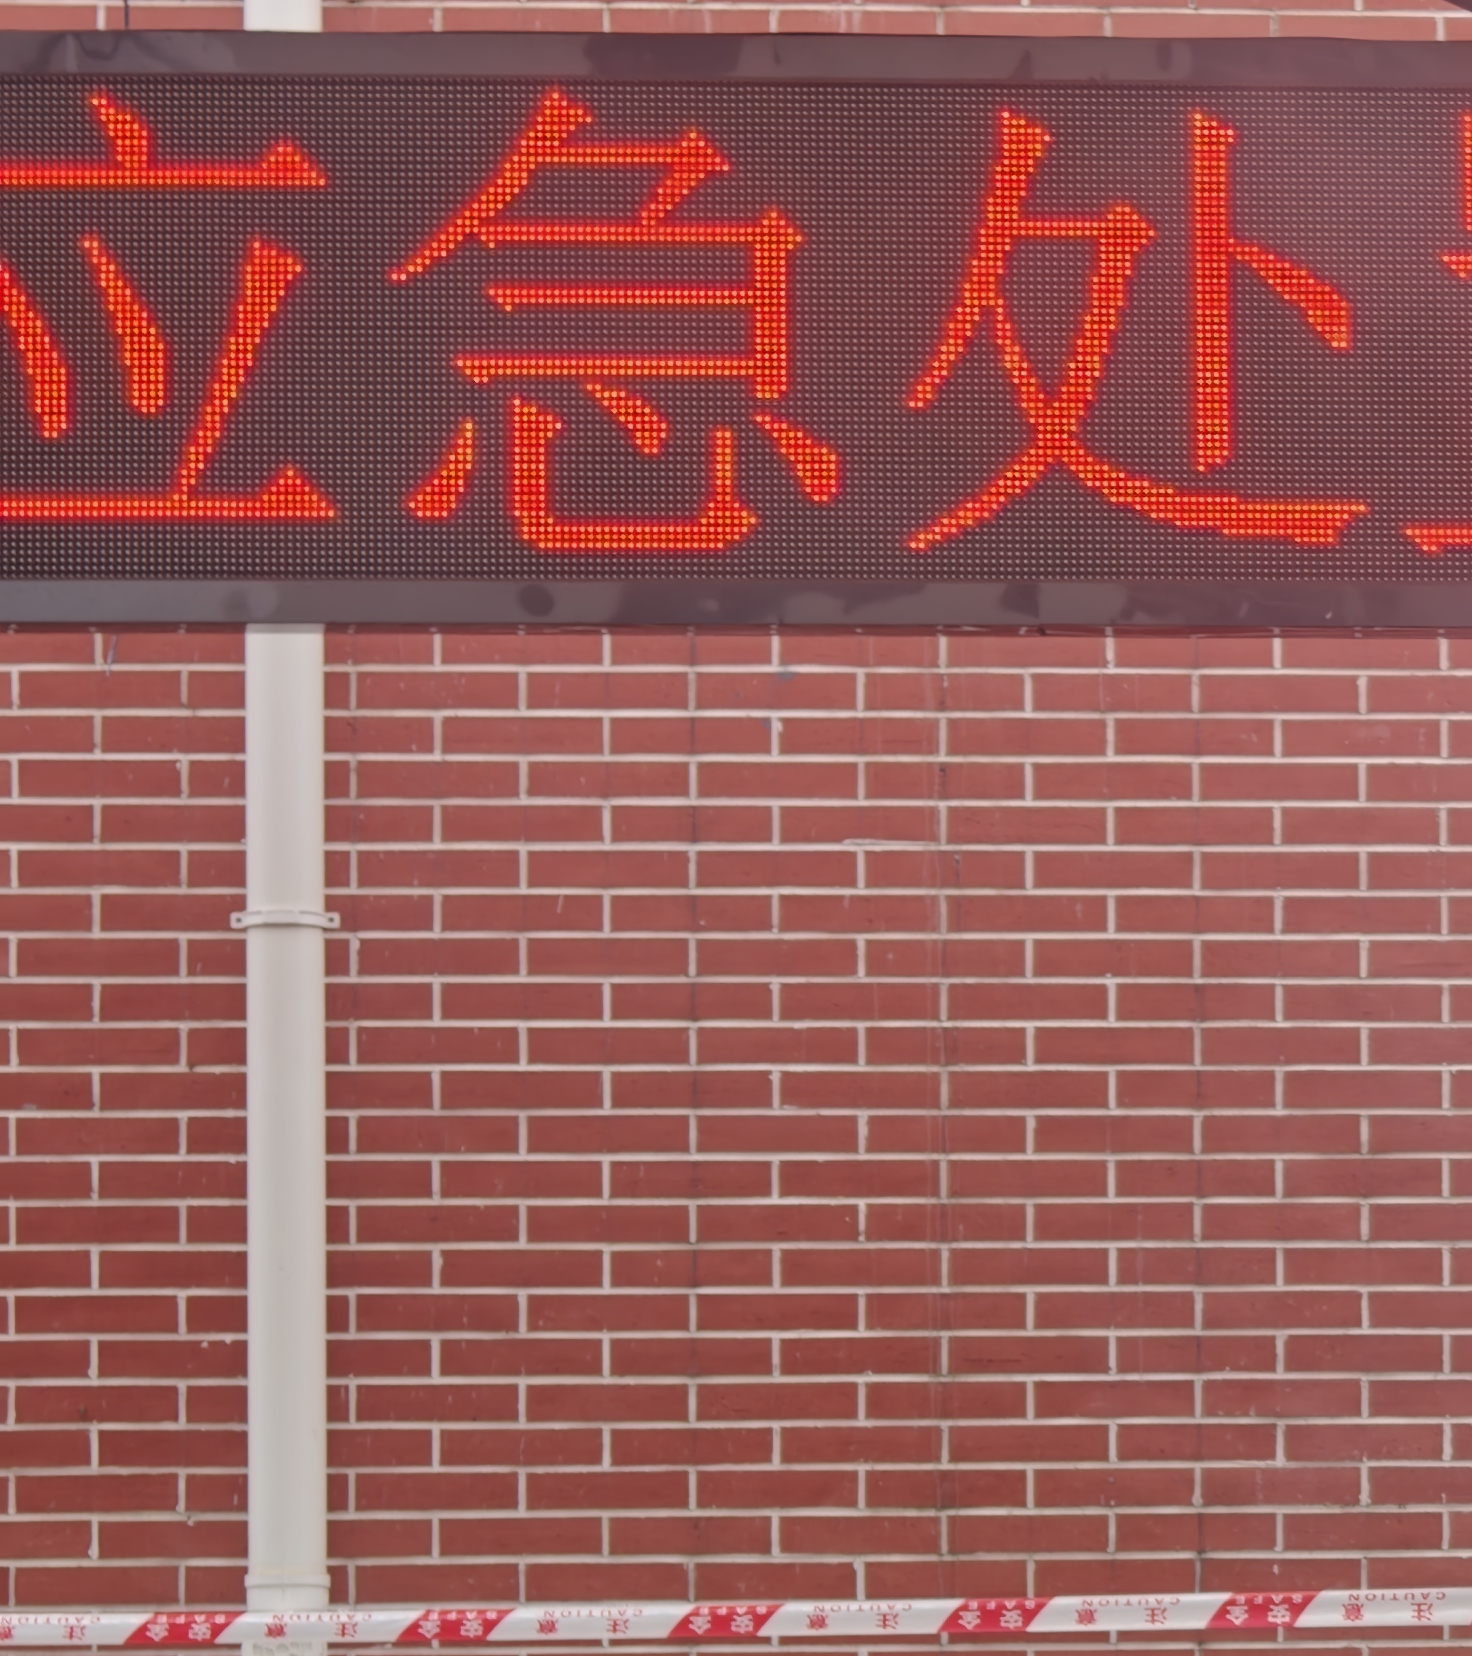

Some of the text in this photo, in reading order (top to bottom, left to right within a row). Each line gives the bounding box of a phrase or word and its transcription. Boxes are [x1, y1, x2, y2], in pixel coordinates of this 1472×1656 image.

[1081, 1597, 1180, 1607] CAUTION
[1236, 1594, 1303, 1604] SAFE
[1349, 1591, 1446, 1601] CAUTION
[698, 1605, 767, 1616] SAFE
[813, 1603, 912, 1613] CAUTION
[968, 1599, 1035, 1610] SAFE
[156, 1613, 225, 1624] SAFE
[429, 1610, 497, 1620] SAFE
[544, 1609, 643, 1618] CAUTION
[1075, 1607, 1168, 1626] 注意
[1226, 1605, 1291, 1624] 安全
[1342, 1602, 1433, 1622] 注意
[273, 1614, 372, 1624] CAUTION
[689, 1615, 754, 1633] 安全
[807, 1613, 899, 1631] 注意
[958, 1610, 1023, 1628] 安全
[146, 1623, 211, 1641] 安全
[265, 1622, 358, 1638] 注意
[418, 1619, 484, 1638] 安全
[537, 1618, 629, 1635] 注意
